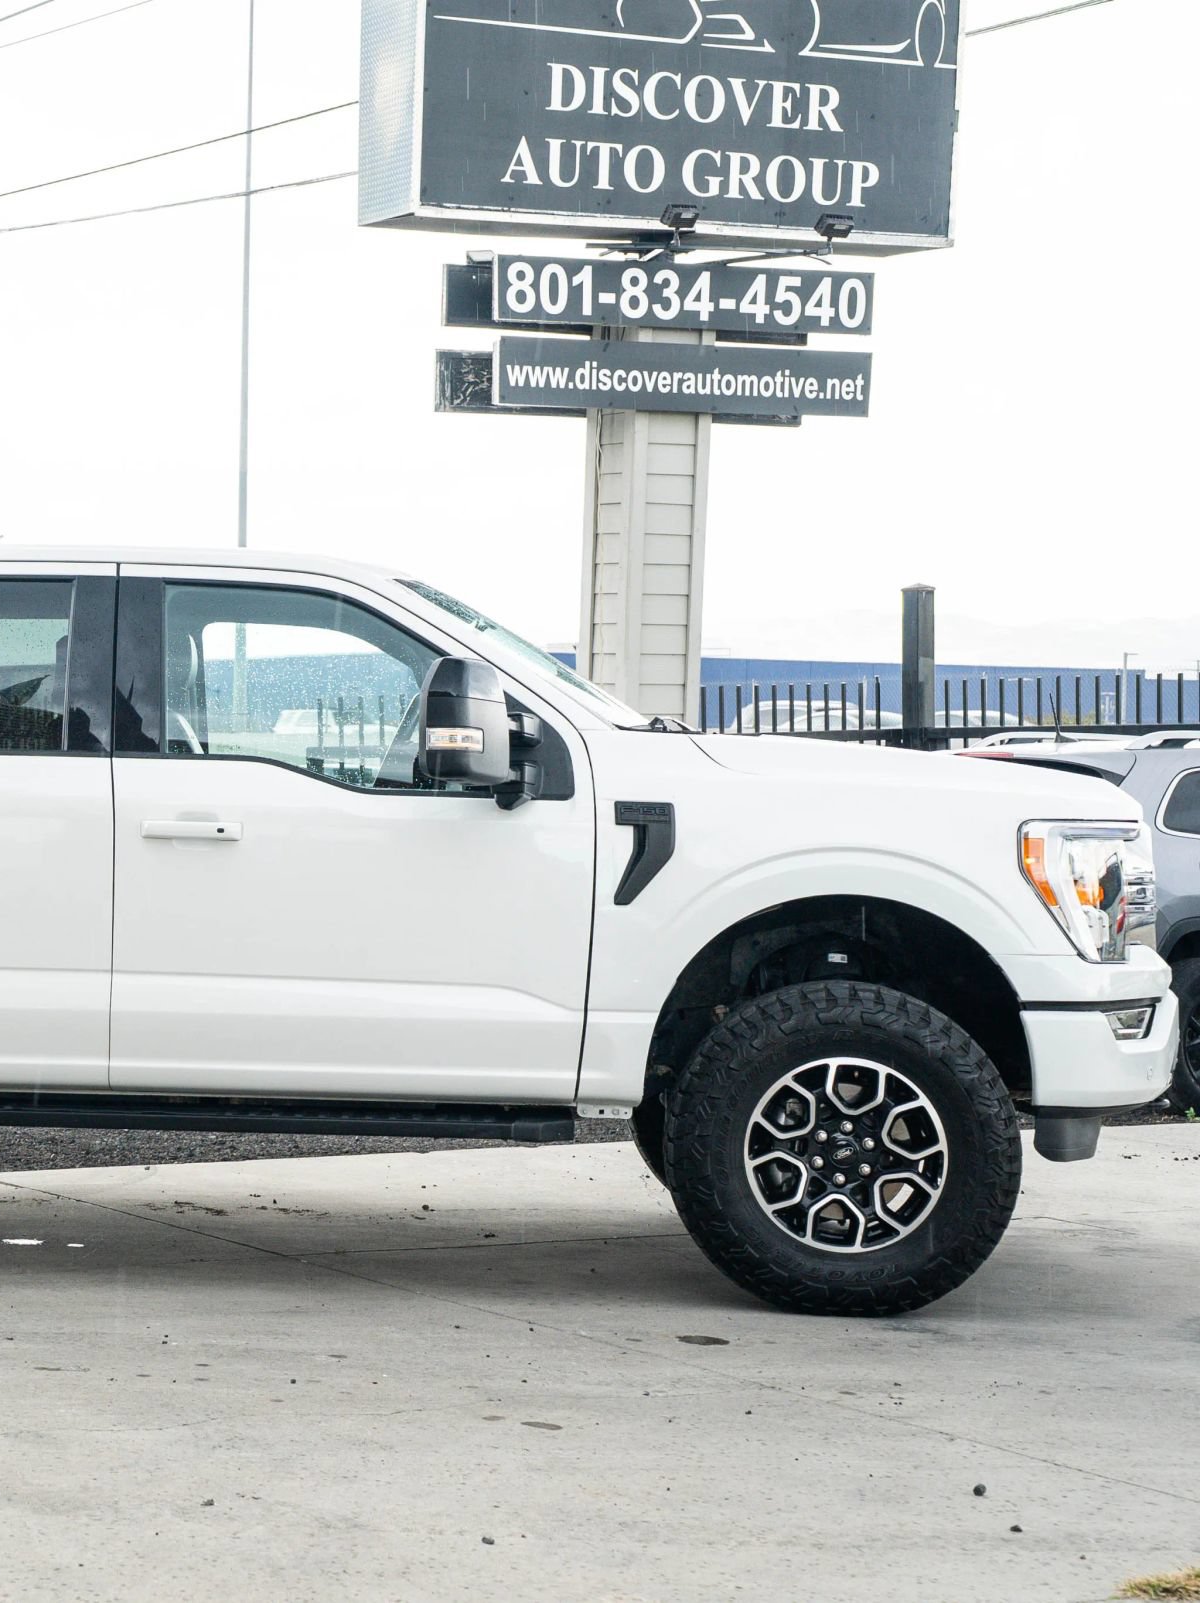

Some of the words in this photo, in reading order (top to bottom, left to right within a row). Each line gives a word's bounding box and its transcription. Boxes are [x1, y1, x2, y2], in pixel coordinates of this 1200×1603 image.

[544, 62, 845, 133] DISCOVER
[500, 135, 667, 194] AUTO
[681, 148, 880, 208] GROUP
[505, 261, 868, 329] 801-834-4540
[505, 360, 866, 401] www.discoverautomotive.net
[620, 805, 669, 816] F-150
